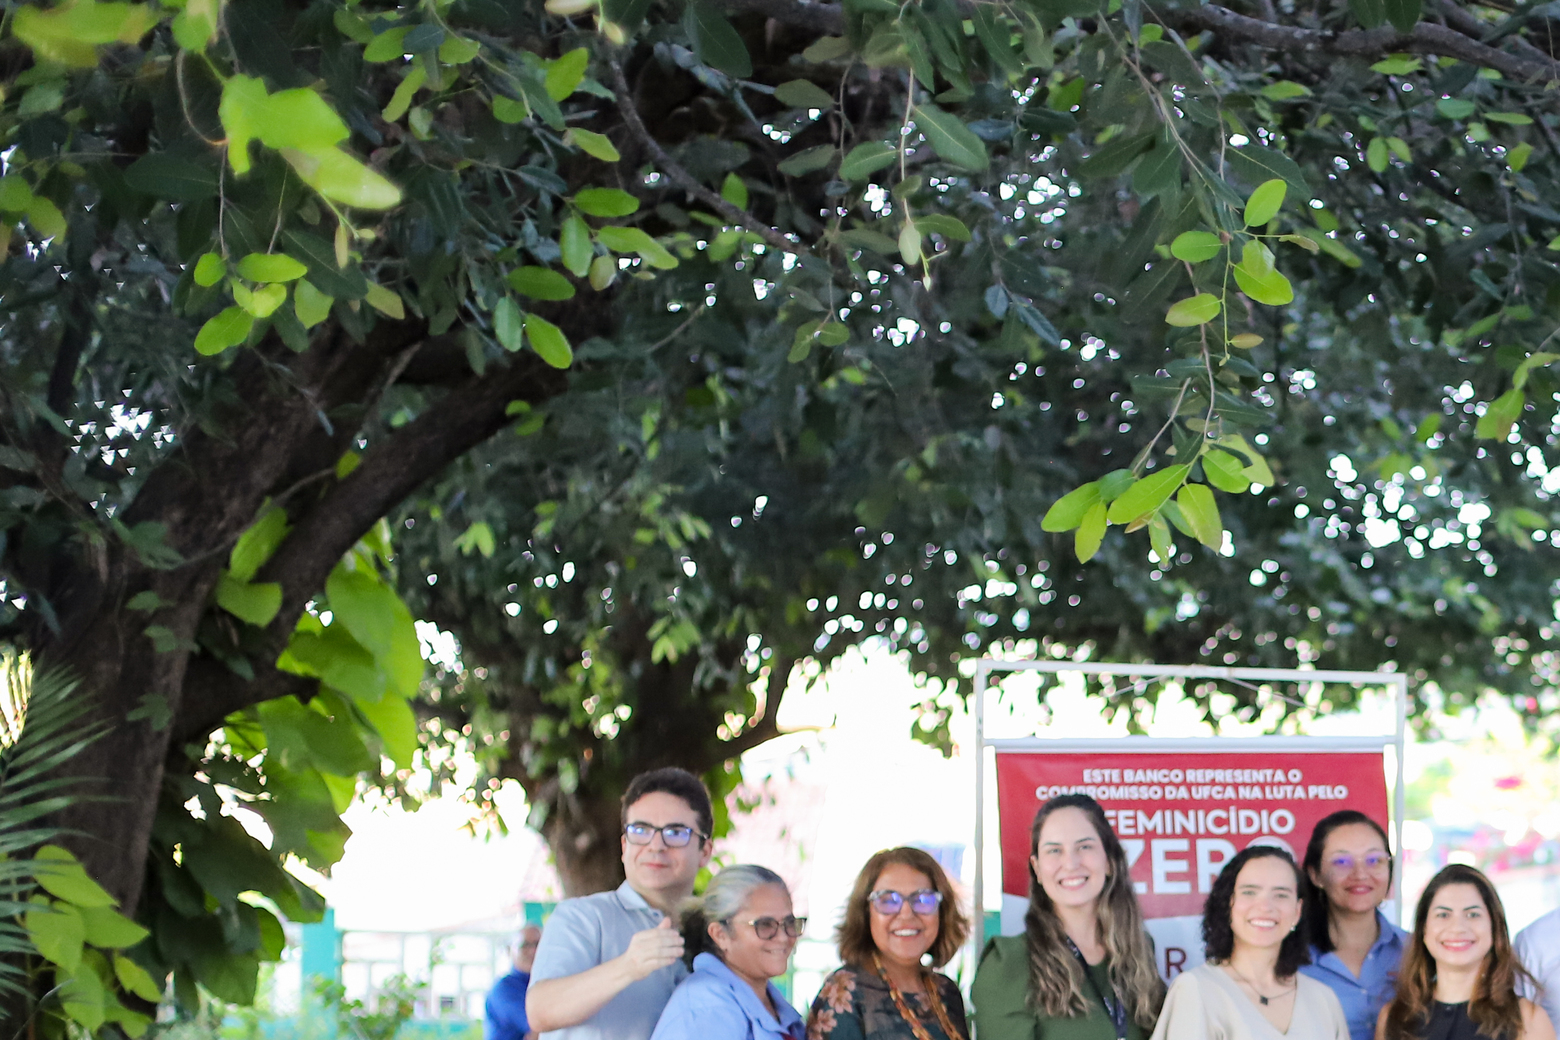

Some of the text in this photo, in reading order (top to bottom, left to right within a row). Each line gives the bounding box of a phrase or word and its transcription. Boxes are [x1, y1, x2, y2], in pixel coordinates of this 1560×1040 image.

[1083, 768, 1303, 783] ESTE BANCO REPRESENTA O
[1164, 785, 1190, 800] DA
[1191, 785, 1237, 800] UFCA
[1238, 785, 1263, 799] NA
[1264, 785, 1306, 799] LUTA
[1307, 784, 1349, 799] PELO
[1120, 836, 1297, 894] ZER
